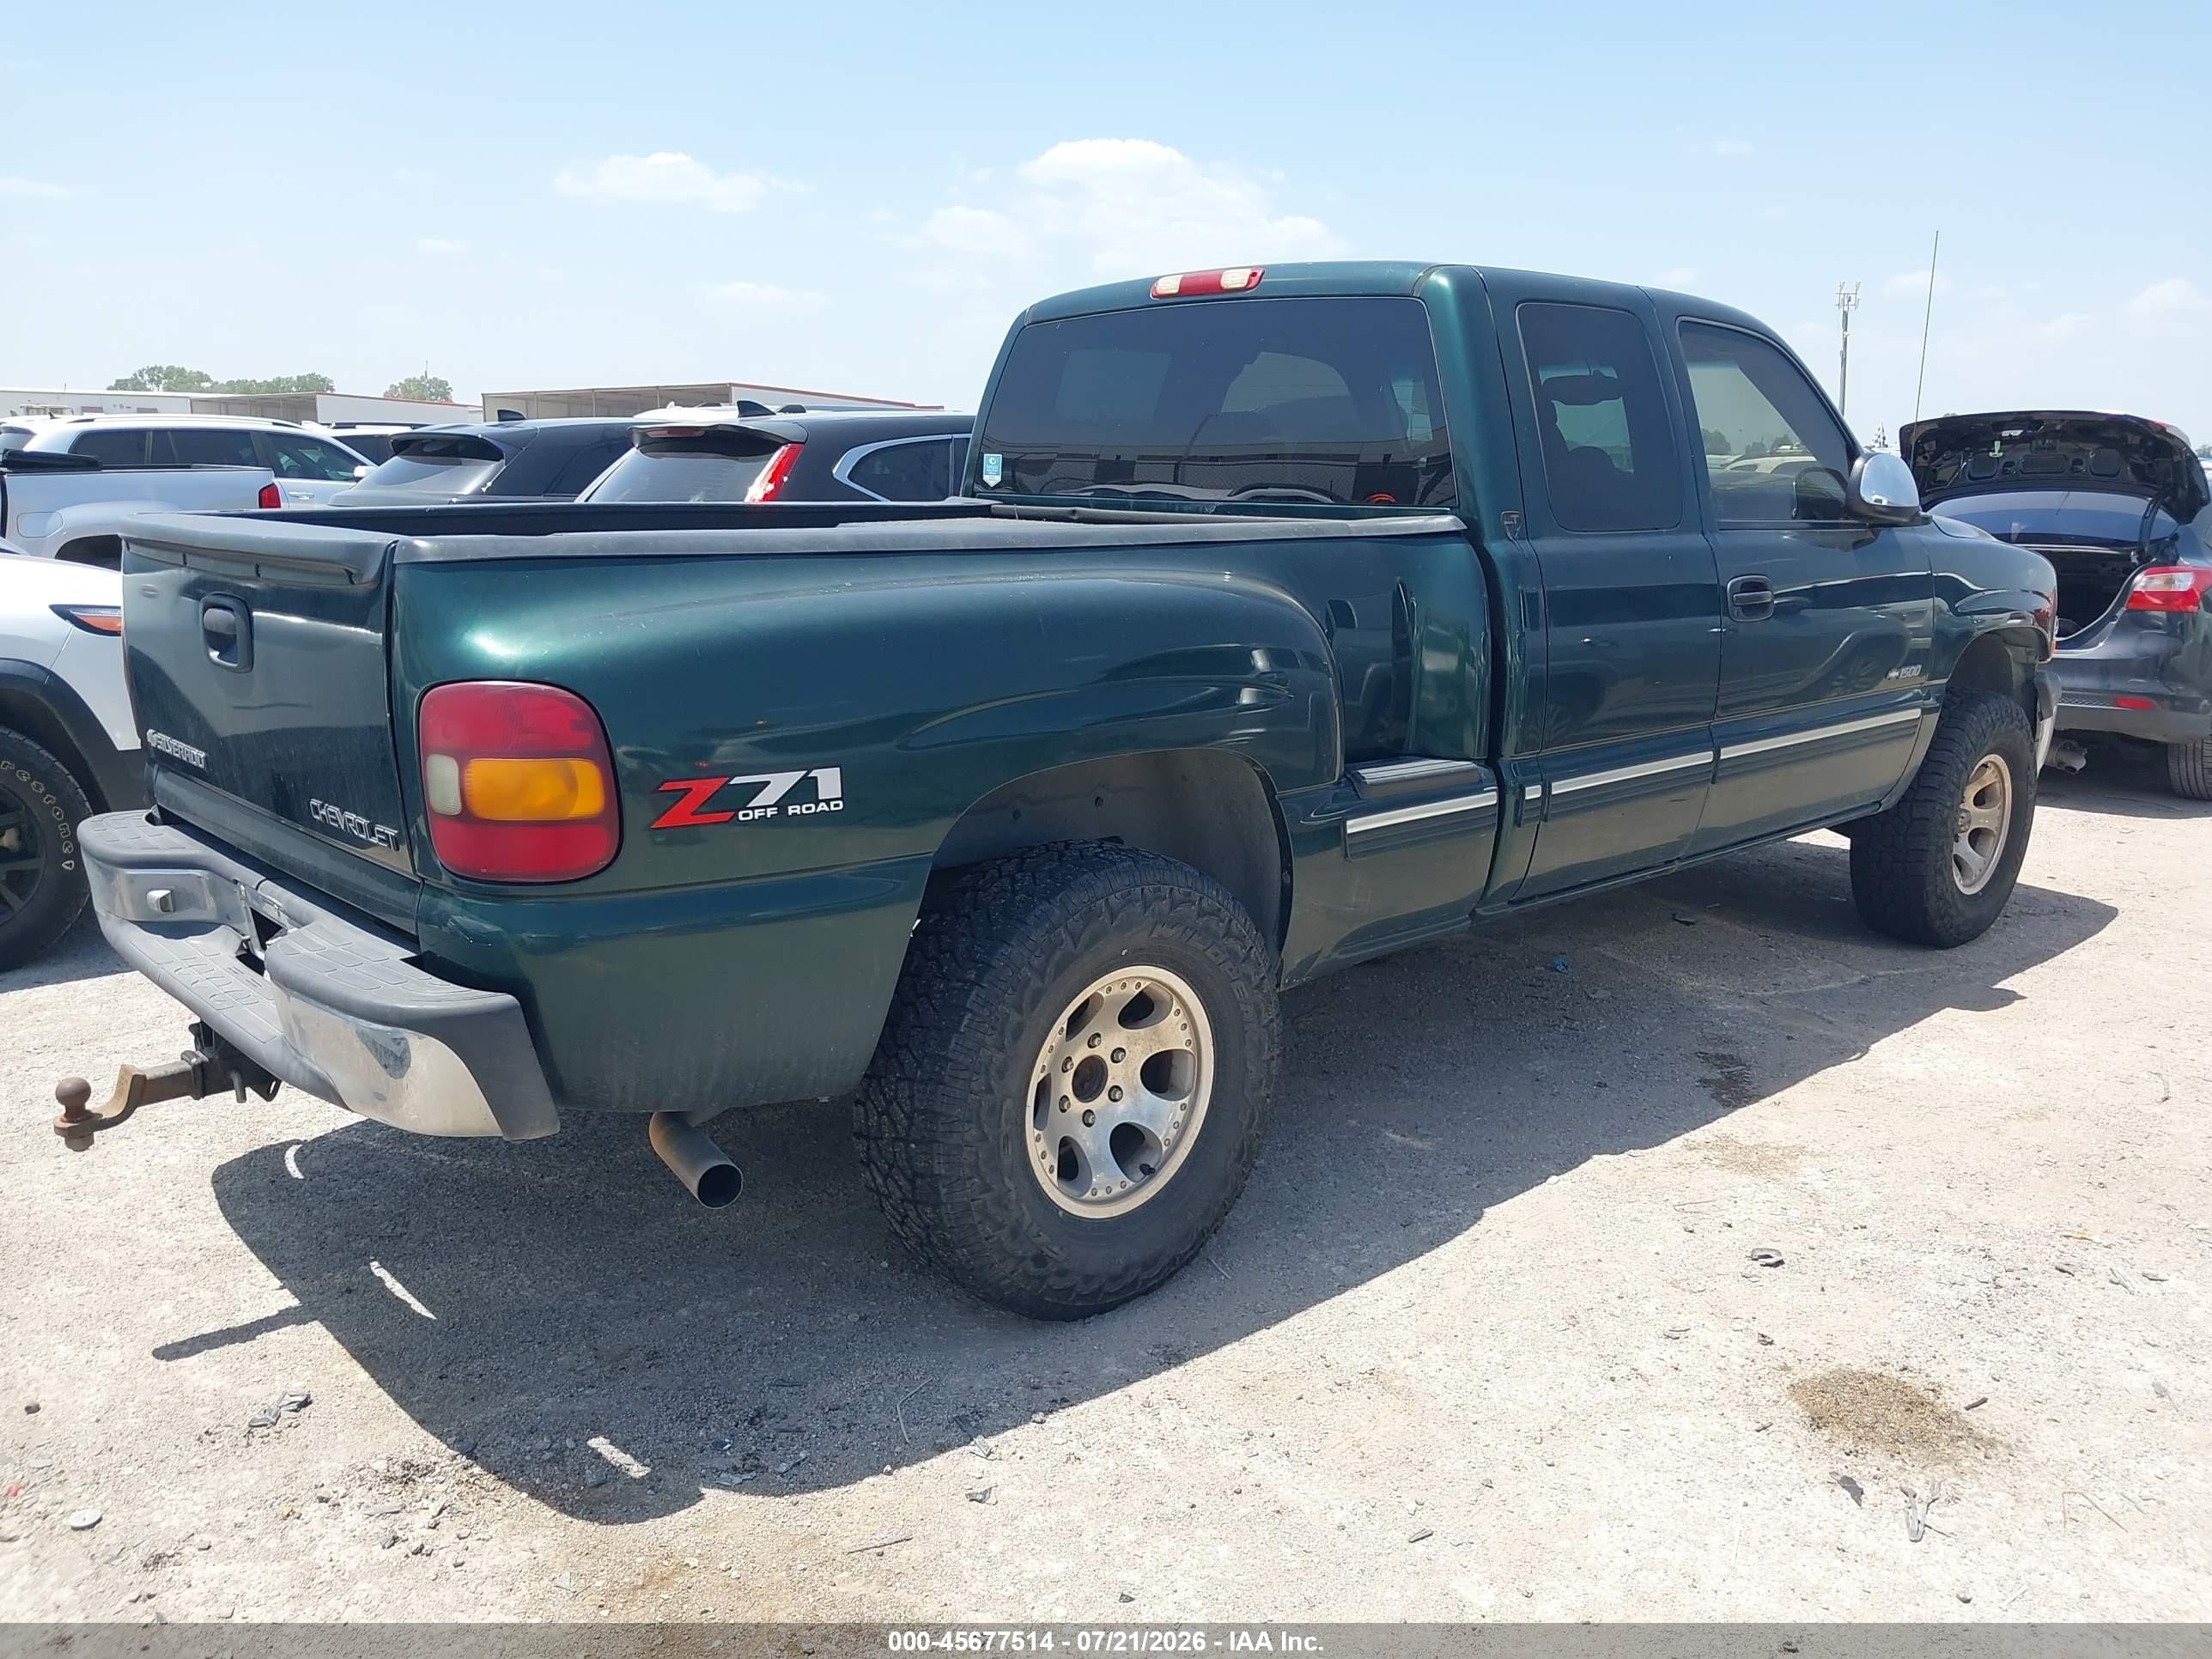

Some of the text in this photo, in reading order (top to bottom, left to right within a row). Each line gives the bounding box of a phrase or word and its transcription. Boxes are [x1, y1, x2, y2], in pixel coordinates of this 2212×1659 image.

[1899, 664, 1923, 678] 1500
[155, 732, 206, 769] SILVERADO
[650, 767, 842, 829] Z71
[738, 800, 844, 822] OFF ROAD
[309, 798, 399, 850] CHEVROLET
